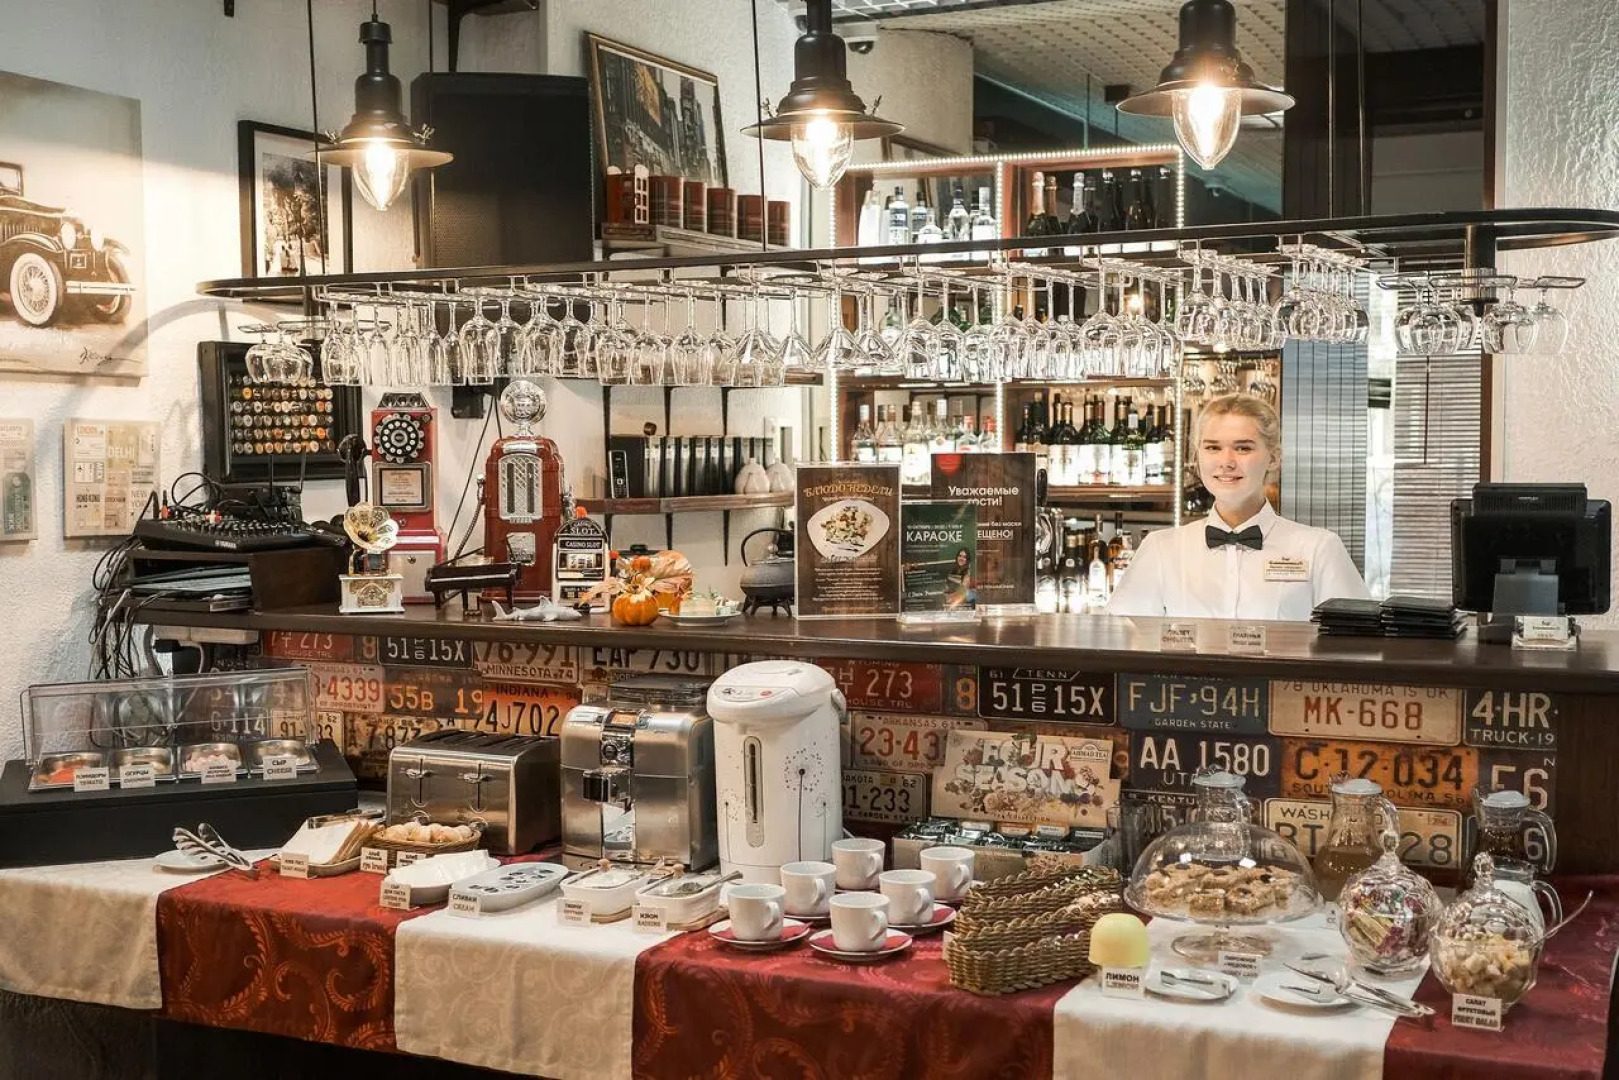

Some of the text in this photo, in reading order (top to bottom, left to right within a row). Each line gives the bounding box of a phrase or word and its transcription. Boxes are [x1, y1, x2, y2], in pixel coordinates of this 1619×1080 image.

[948, 486, 1019, 497] Уважаемые
[571, 528, 596, 536] SLOT
[906, 530, 963, 543] КАРАОКЕ
[977, 530, 1014, 540] ЕЩЕНО!
[387, 637, 465, 662] 51 15X
[486, 663, 551, 678] MINNESOTA
[1028, 669, 1069, 680] TENN
[495, 684, 550, 699] INDIANA
[866, 669, 913, 700] 273
[391, 685, 435, 712] 55B
[956, 677, 977, 711] 8
[992, 682, 1105, 717] 51 15X
[1311, 683, 1395, 697] OKLAHOMA
[1403, 687, 1417, 700] IS
[1425, 687, 1449, 702] OK
[1302, 696, 1423, 731] MK-668
[1154, 717, 1231, 730] GARDEN STATE
[1140, 736, 1271, 777] AA 1580
[956, 765, 1074, 799] SEASON
[1163, 771, 1198, 786] UTA
[1147, 795, 1196, 806] KENTU
[1292, 782, 1325, 795] SOU
[1383, 789, 1435, 804] OLINA
[1280, 807, 1330, 824] WASH
[452, 893, 478, 902] СЛИВКИ
[1105, 972, 1140, 983] ЛИМОН
[1465, 998, 1487, 1006] САЛАТ
